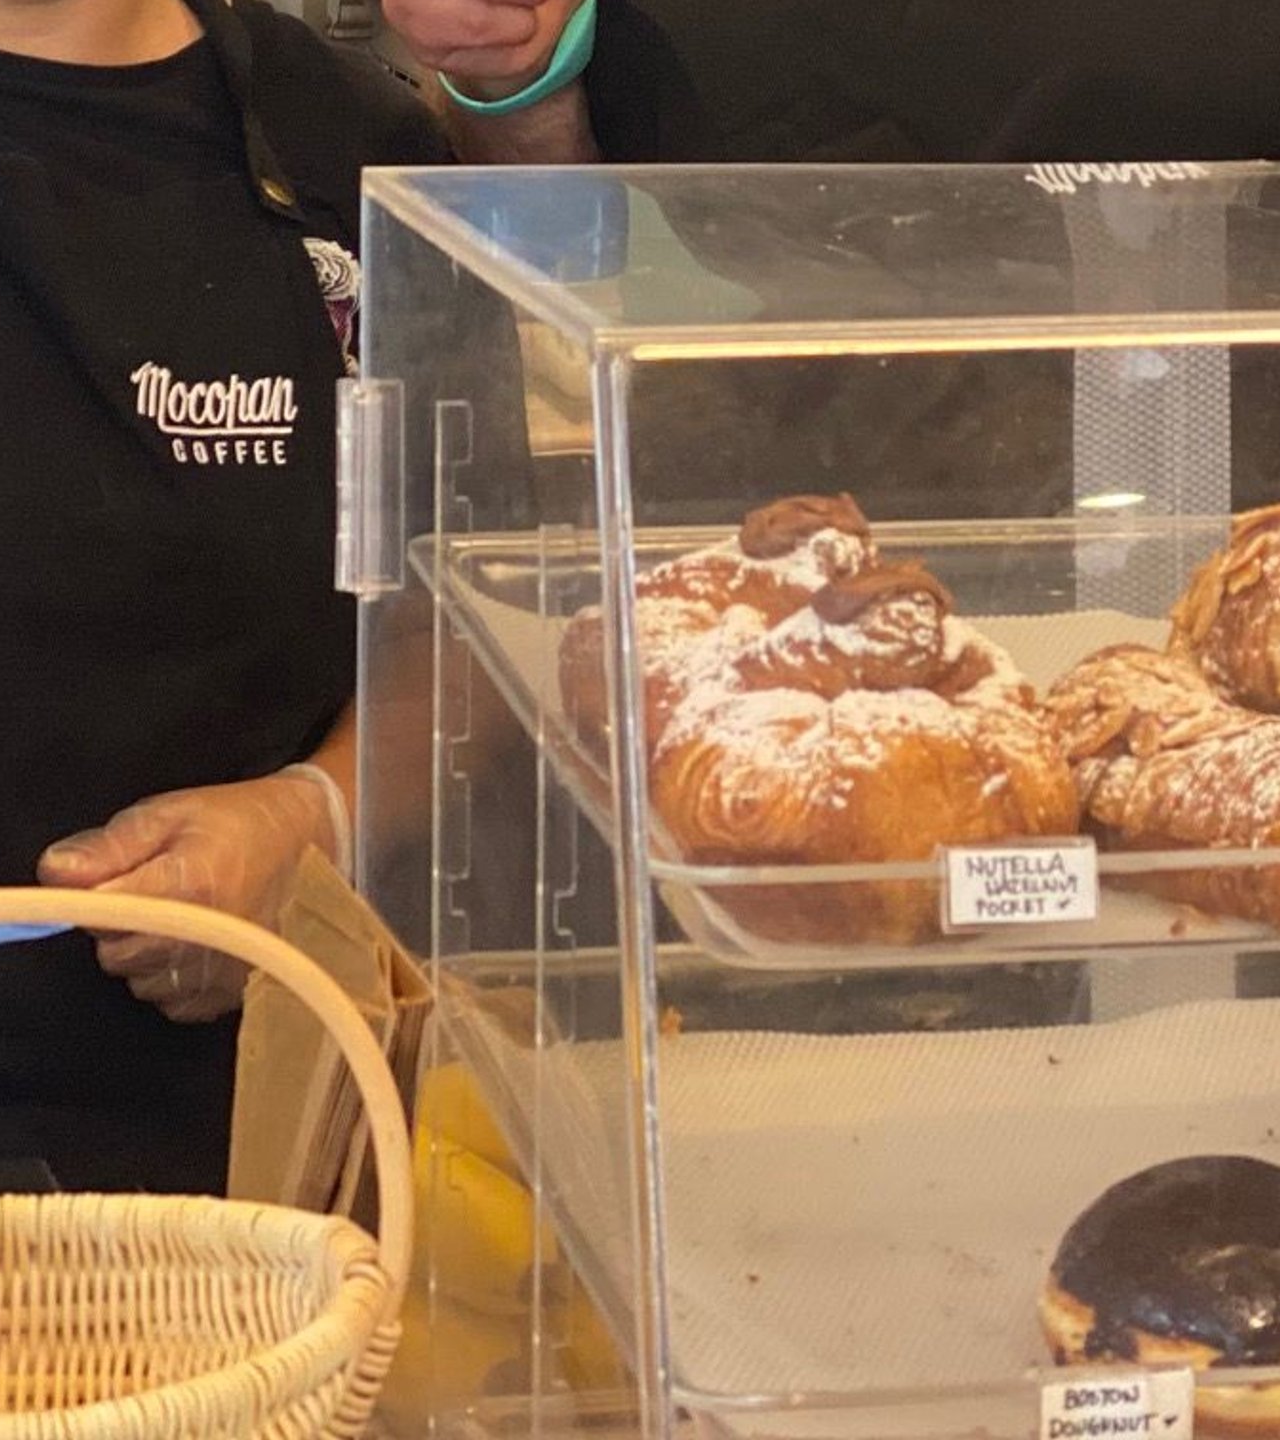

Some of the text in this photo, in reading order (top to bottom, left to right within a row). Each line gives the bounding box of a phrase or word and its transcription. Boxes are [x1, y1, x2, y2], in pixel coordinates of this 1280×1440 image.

[130, 361, 298, 436] Mocopan
[172, 438, 287, 466] COFFEE
[965, 851, 1066, 877] NUTELLA
[976, 897, 1045, 916] POCKET
[1064, 1385, 1140, 1410] BOSTON
[1048, 1413, 1160, 1439] DOUGHNUT
